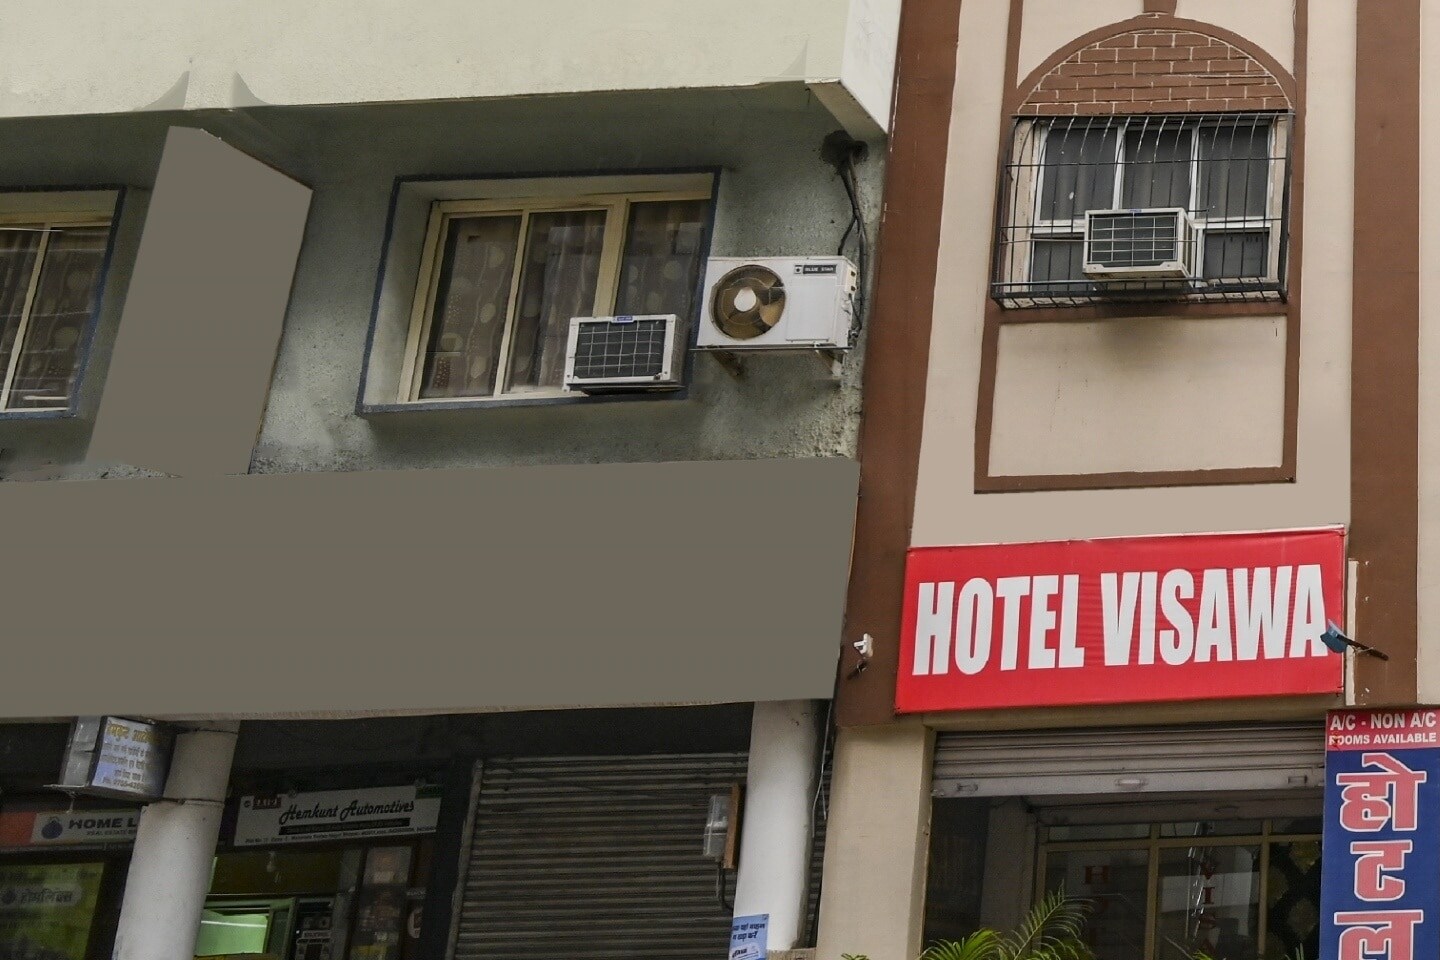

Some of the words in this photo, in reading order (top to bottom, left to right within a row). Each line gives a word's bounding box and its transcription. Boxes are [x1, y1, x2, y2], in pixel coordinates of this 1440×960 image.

[912, 573, 1085, 676] HOTEL
[1101, 563, 1329, 667] VISAWA
[1330, 714, 1356, 731] A/C
[1370, 713, 1405, 729] NON
[1410, 712, 1436, 729] A/C
[1329, 734, 1370, 746] ROOMS
[1373, 732, 1437, 744] AVAILABLE
[278, 802, 338, 825] Hemkunt
[339, 800, 415, 821] Automotives
[68, 817, 123, 829] HOME
